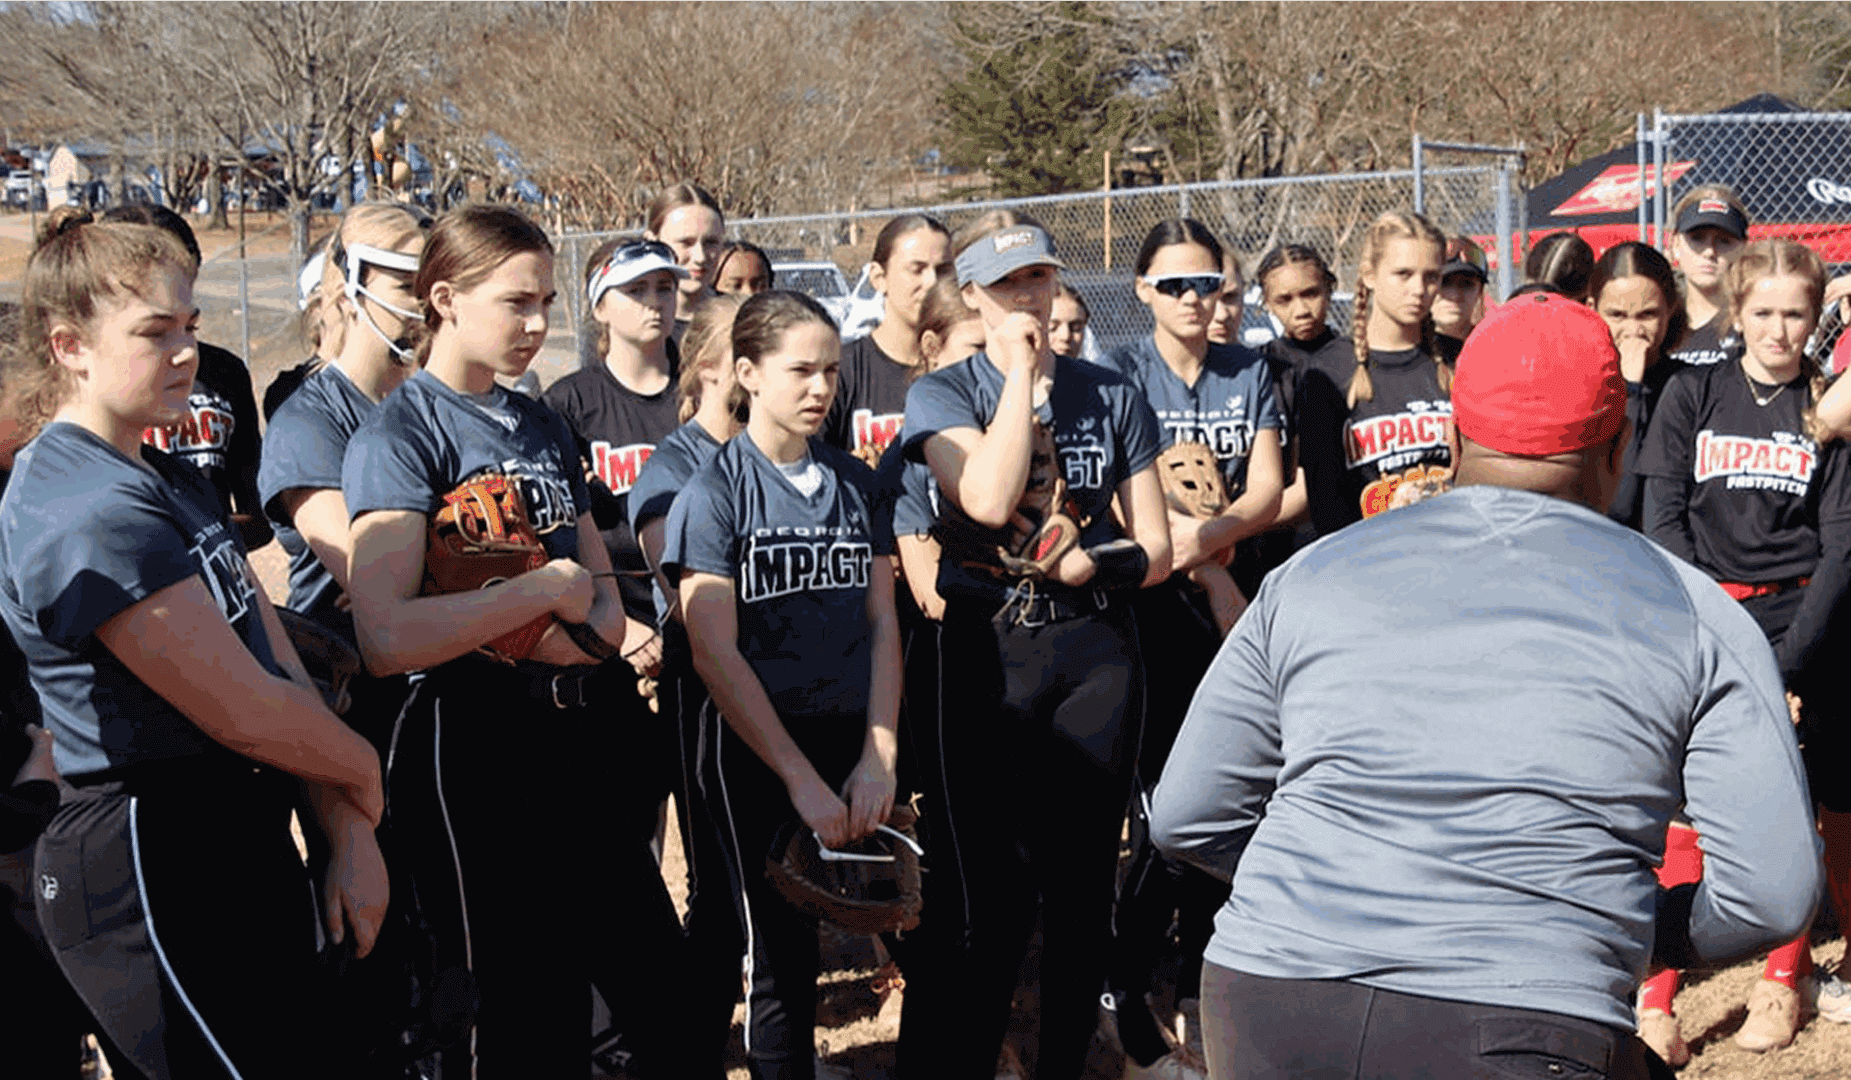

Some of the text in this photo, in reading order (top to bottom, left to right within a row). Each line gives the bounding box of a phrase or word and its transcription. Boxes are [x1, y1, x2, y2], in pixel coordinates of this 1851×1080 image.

[1343, 411, 1454, 470] IMPACT
[1695, 430, 1817, 484] IMPACT
[1727, 475, 1808, 497] FASTPITCH
[741, 534, 873, 603] IMPACT
